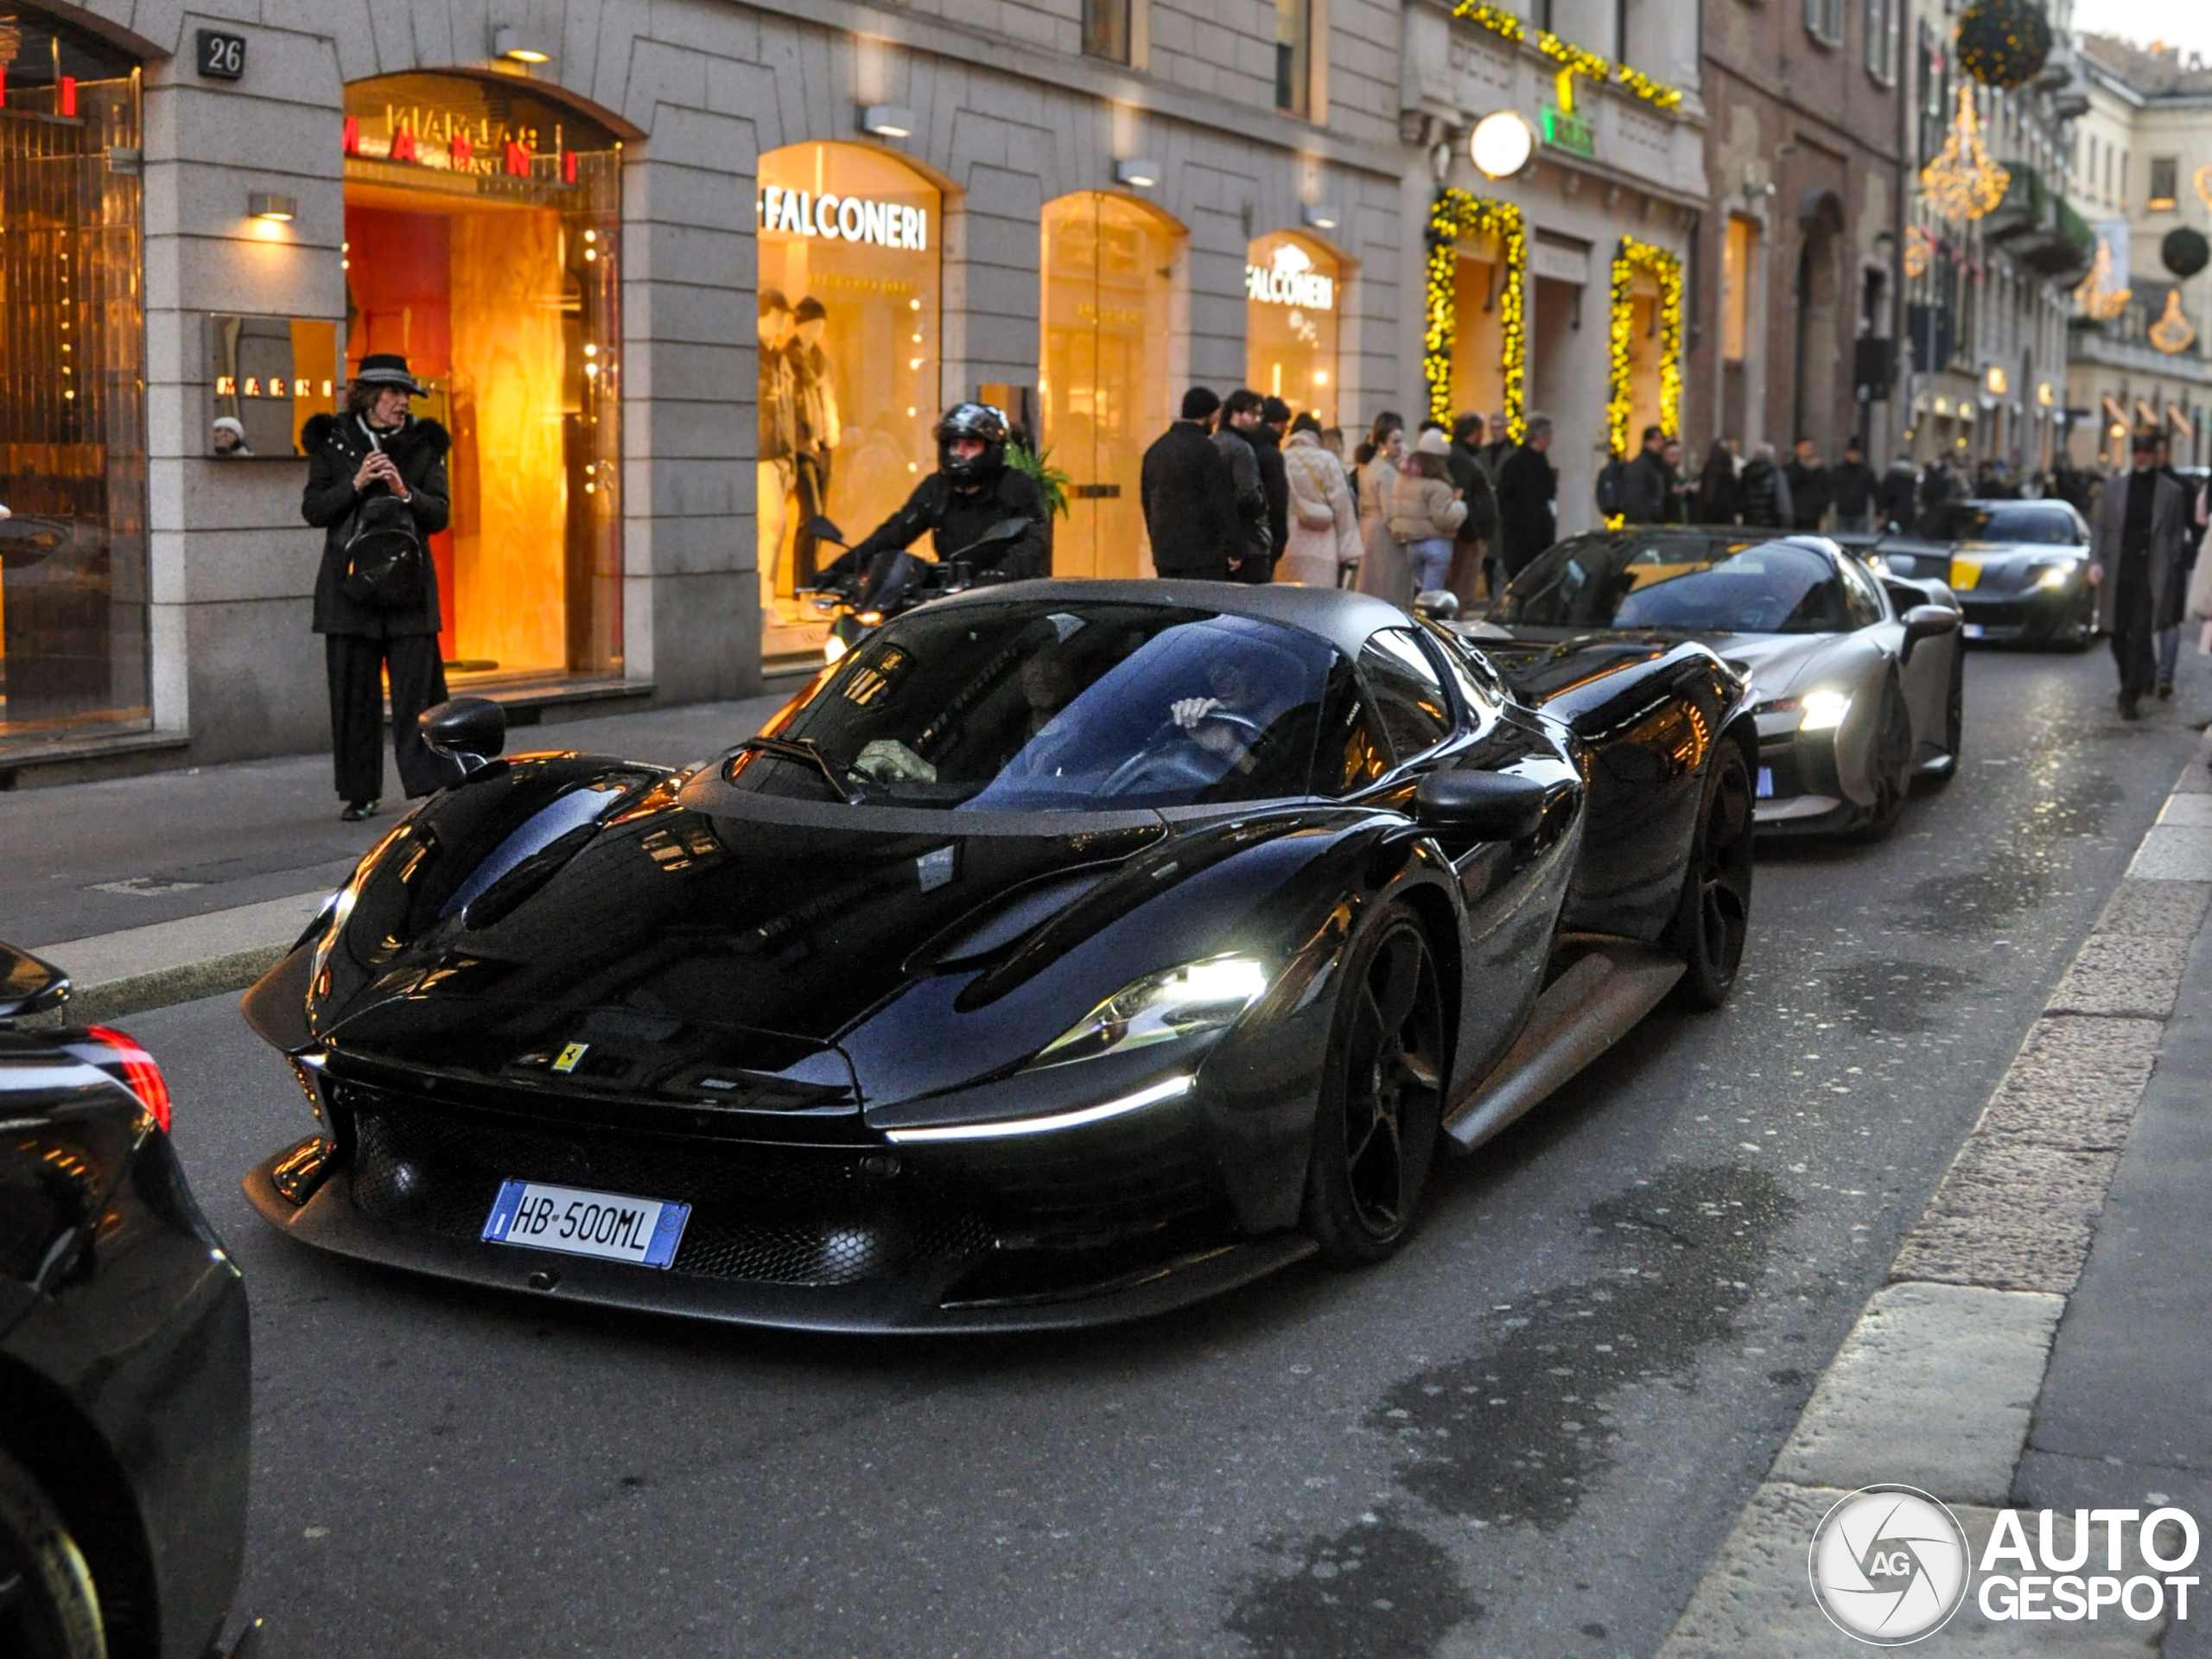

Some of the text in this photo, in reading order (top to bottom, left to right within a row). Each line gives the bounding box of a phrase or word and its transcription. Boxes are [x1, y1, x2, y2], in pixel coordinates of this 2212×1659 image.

[209, 37, 241, 72] 26
[763, 186, 926, 251] FALCONERI
[512, 1196, 554, 1234] HB
[560, 1202, 645, 1250] 500ML
